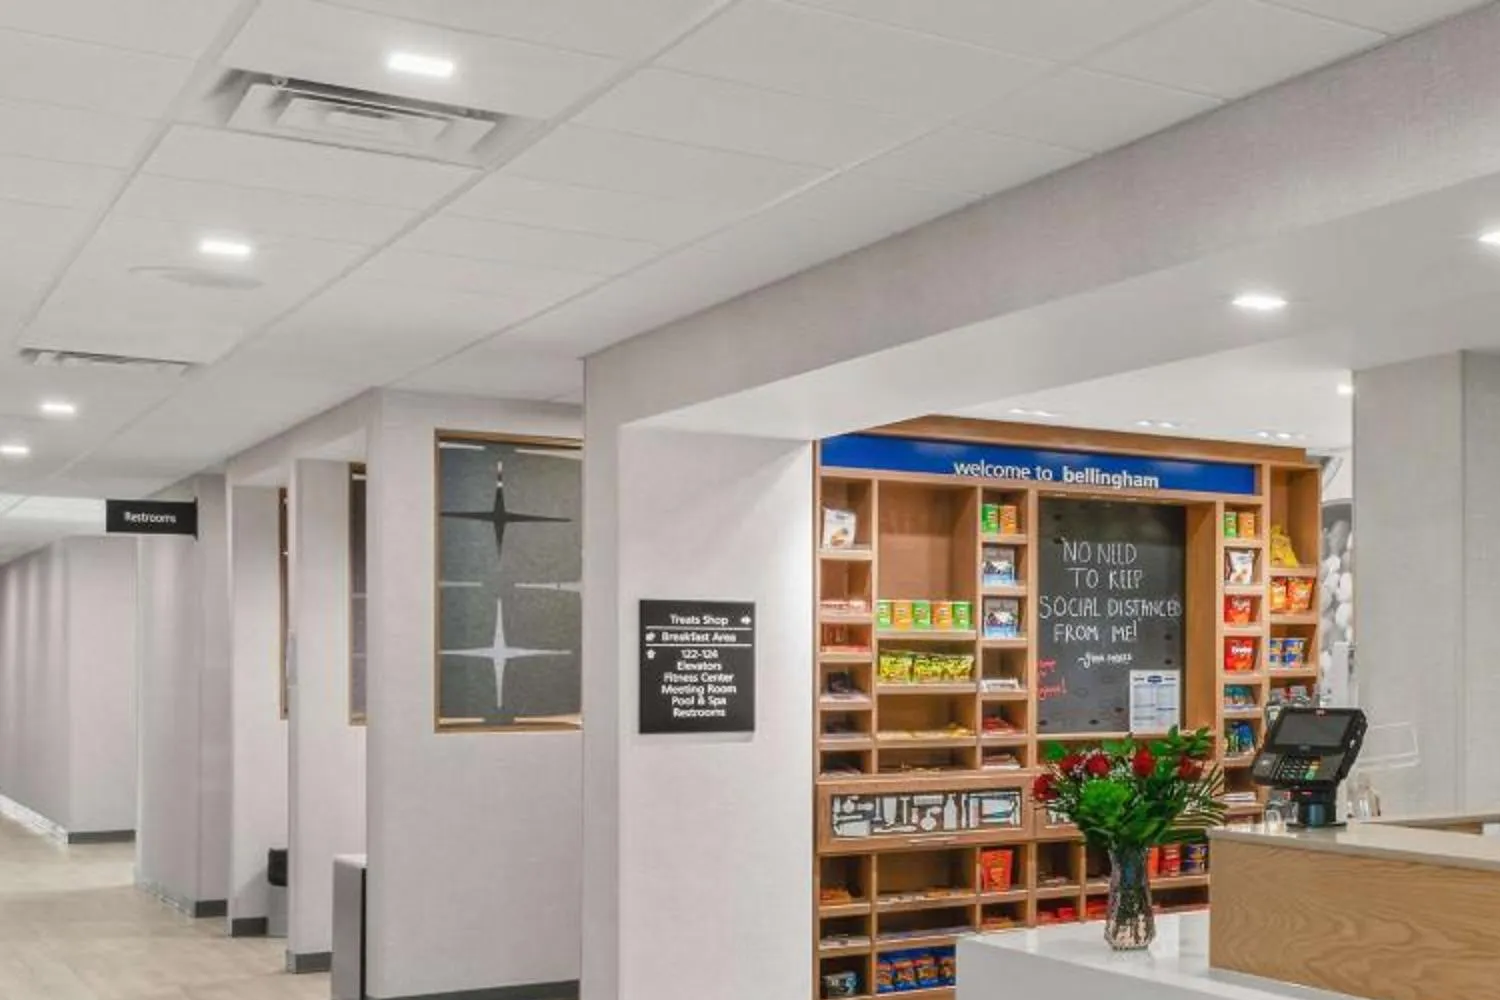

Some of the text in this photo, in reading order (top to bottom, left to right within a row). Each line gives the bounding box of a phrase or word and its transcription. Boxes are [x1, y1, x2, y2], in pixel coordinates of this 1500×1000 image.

[954, 459, 1160, 489] welcome to bellingham
[124, 511, 177, 523] Restrooms
[1063, 540, 1138, 565] NO NEED
[1067, 567, 1143, 590] TO KEEP
[1040, 595, 1101, 619] SOCIAL
[670, 614, 729, 627] Treats Shop
[662, 632, 737, 642] Breakfast Area
[1053, 621, 1138, 643] FROM ME!
[681, 649, 718, 659] 122-124
[677, 662, 722, 671] Elevators
[664, 673, 735, 682] Fitness Center
[661, 684, 737, 695] Meeting Room
[672, 696, 727, 707] Pool & Spa
[673, 708, 726, 718] Restrooms
